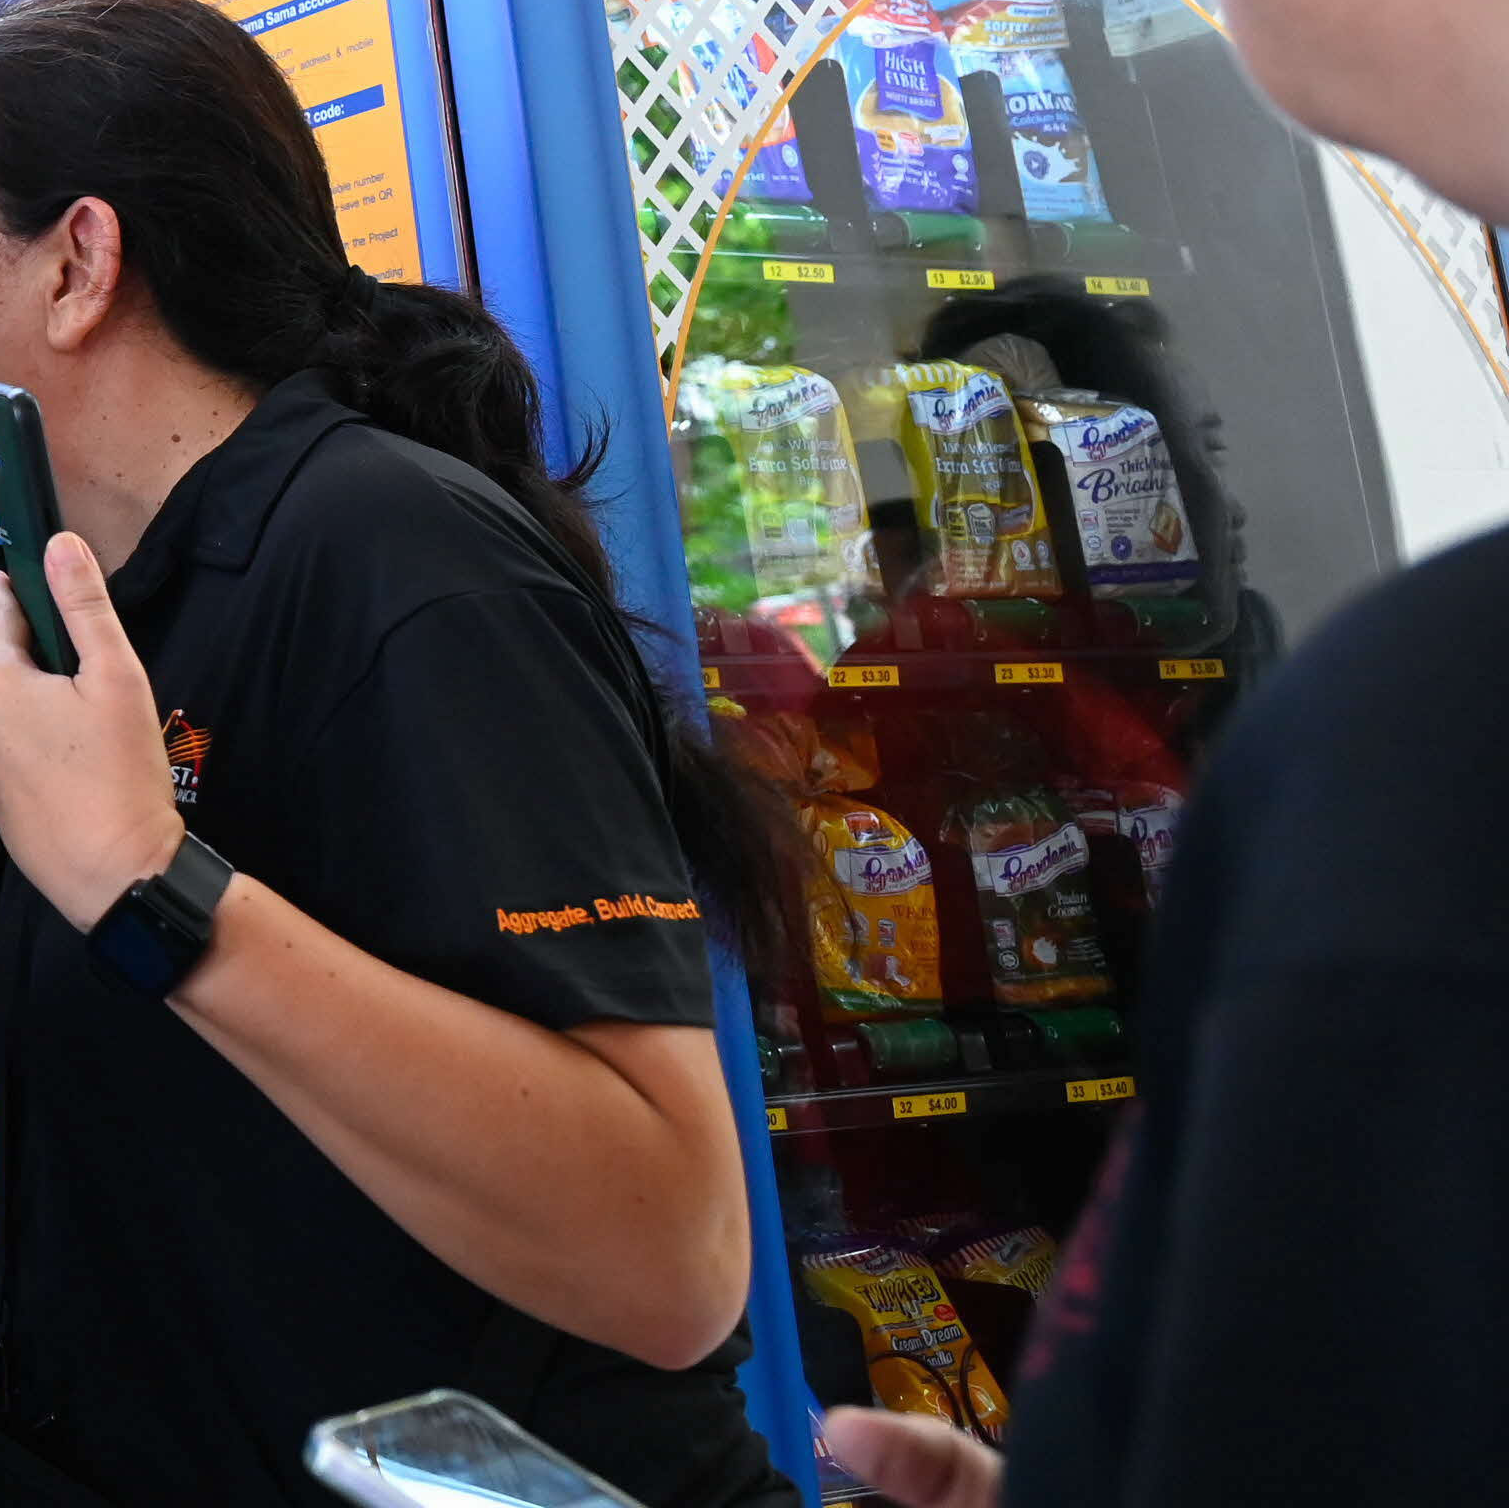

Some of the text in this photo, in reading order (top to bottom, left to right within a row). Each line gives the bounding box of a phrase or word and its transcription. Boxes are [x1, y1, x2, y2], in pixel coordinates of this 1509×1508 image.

[265, 5, 297, 27] Sama
[883, 49, 927, 76] HIGH
[884, 70, 930, 93] FIBRE
[313, 102, 345, 124] code:
[797, 264, 826, 280] $2.50
[862, 669, 891, 685] $3.30
[1027, 665, 1056, 681] $3.30
[495, 894, 701, 935] Aggregate, Connect
[928, 1096, 958, 1113] $4.00
